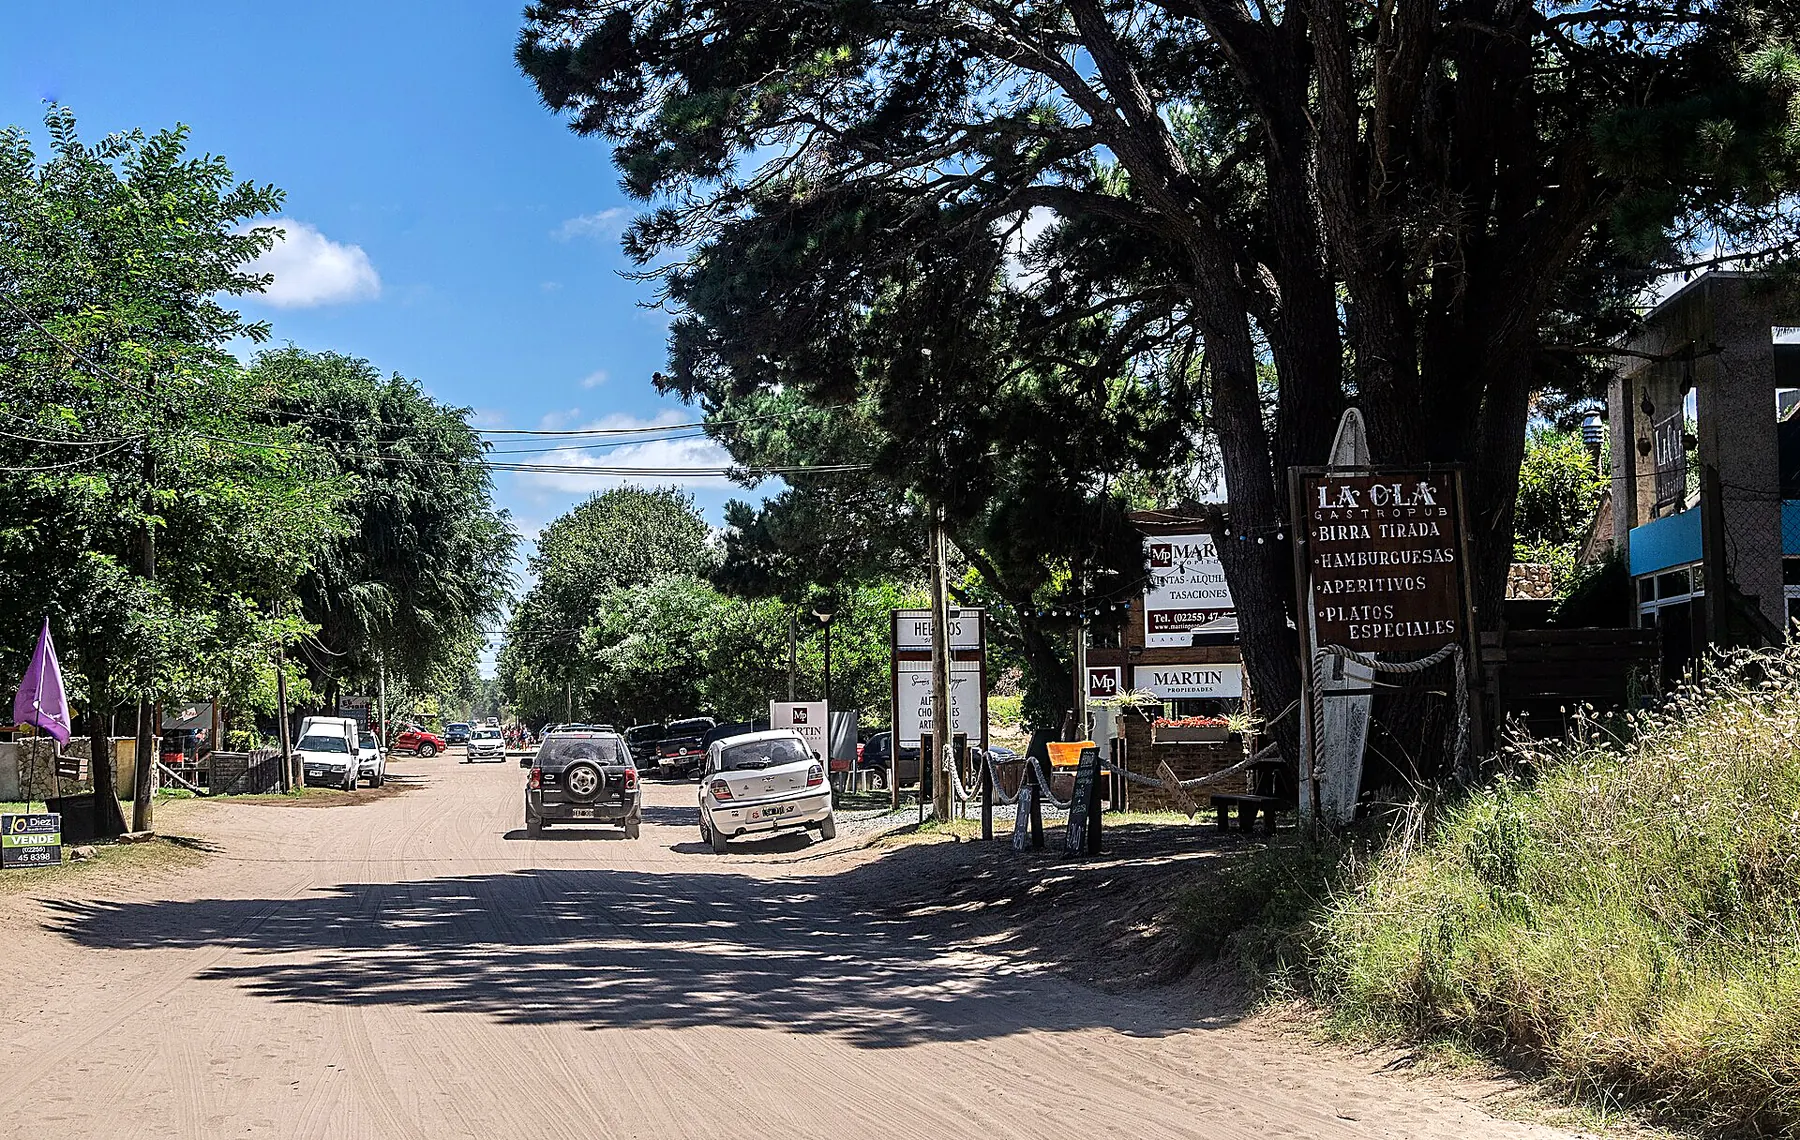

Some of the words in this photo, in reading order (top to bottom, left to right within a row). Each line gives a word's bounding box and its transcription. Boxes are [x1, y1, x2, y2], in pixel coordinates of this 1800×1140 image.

[1317, 485, 1360, 509] LA
[1370, 481, 1437, 507] OLA
[1314, 507, 1448, 522] GASTROPUB
[1319, 524, 1371, 542] BIRRA
[1378, 521, 1441, 539] TIRADA
[1173, 544, 1218, 559] MAR
[1320, 548, 1455, 569] HAMBURGUESAS
[1322, 576, 1427, 595] APERITIVOS
[1170, 589, 1228, 600] TASACIONES
[1153, 614, 1171, 623] Tel.
[1174, 612, 1205, 623] (02255)
[1326, 605, 1394, 622] PLATOS
[1349, 620, 1455, 640] ESPECIALES
[1153, 671, 1222, 686] MARTIN
[30, 817, 51, 826] Diez
[11, 835, 55, 845] VENDE
[30, 853, 51, 861] 8398
